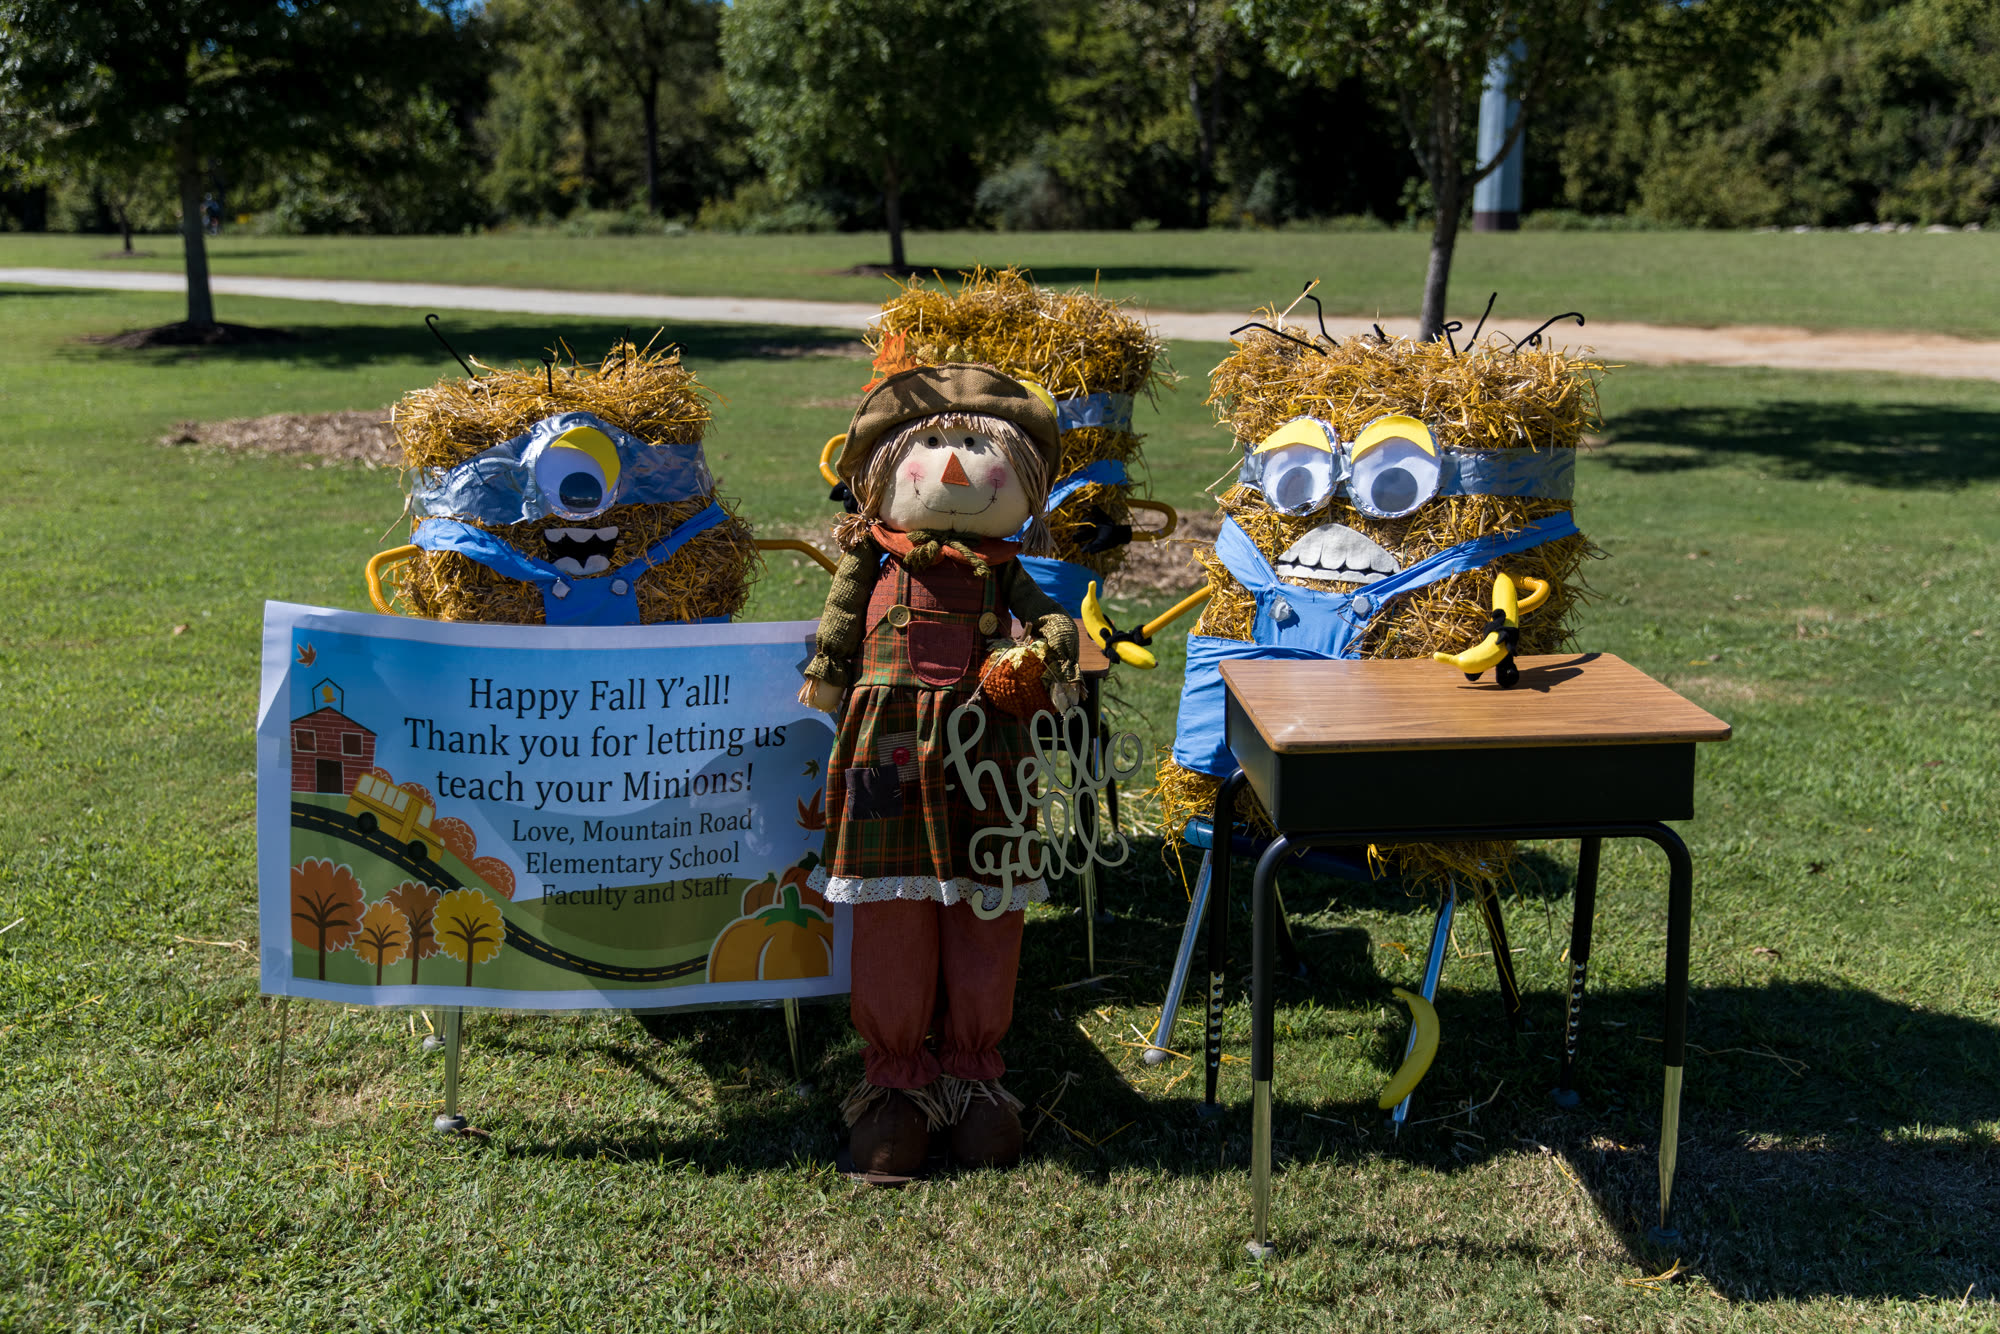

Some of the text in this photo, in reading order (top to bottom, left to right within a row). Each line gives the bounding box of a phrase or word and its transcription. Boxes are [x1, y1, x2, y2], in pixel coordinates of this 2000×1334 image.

[469, 674, 731, 720] Happy Fall Y'all!
[404, 716, 787, 764] Thank you for letting us
[436, 762, 754, 811] teach your Minions!
[943, 704, 1143, 824] hello
[512, 808, 753, 846] Love, Mountain Road
[525, 840, 740, 879] Elementary School
[541, 873, 734, 911] Faculty and Staff
